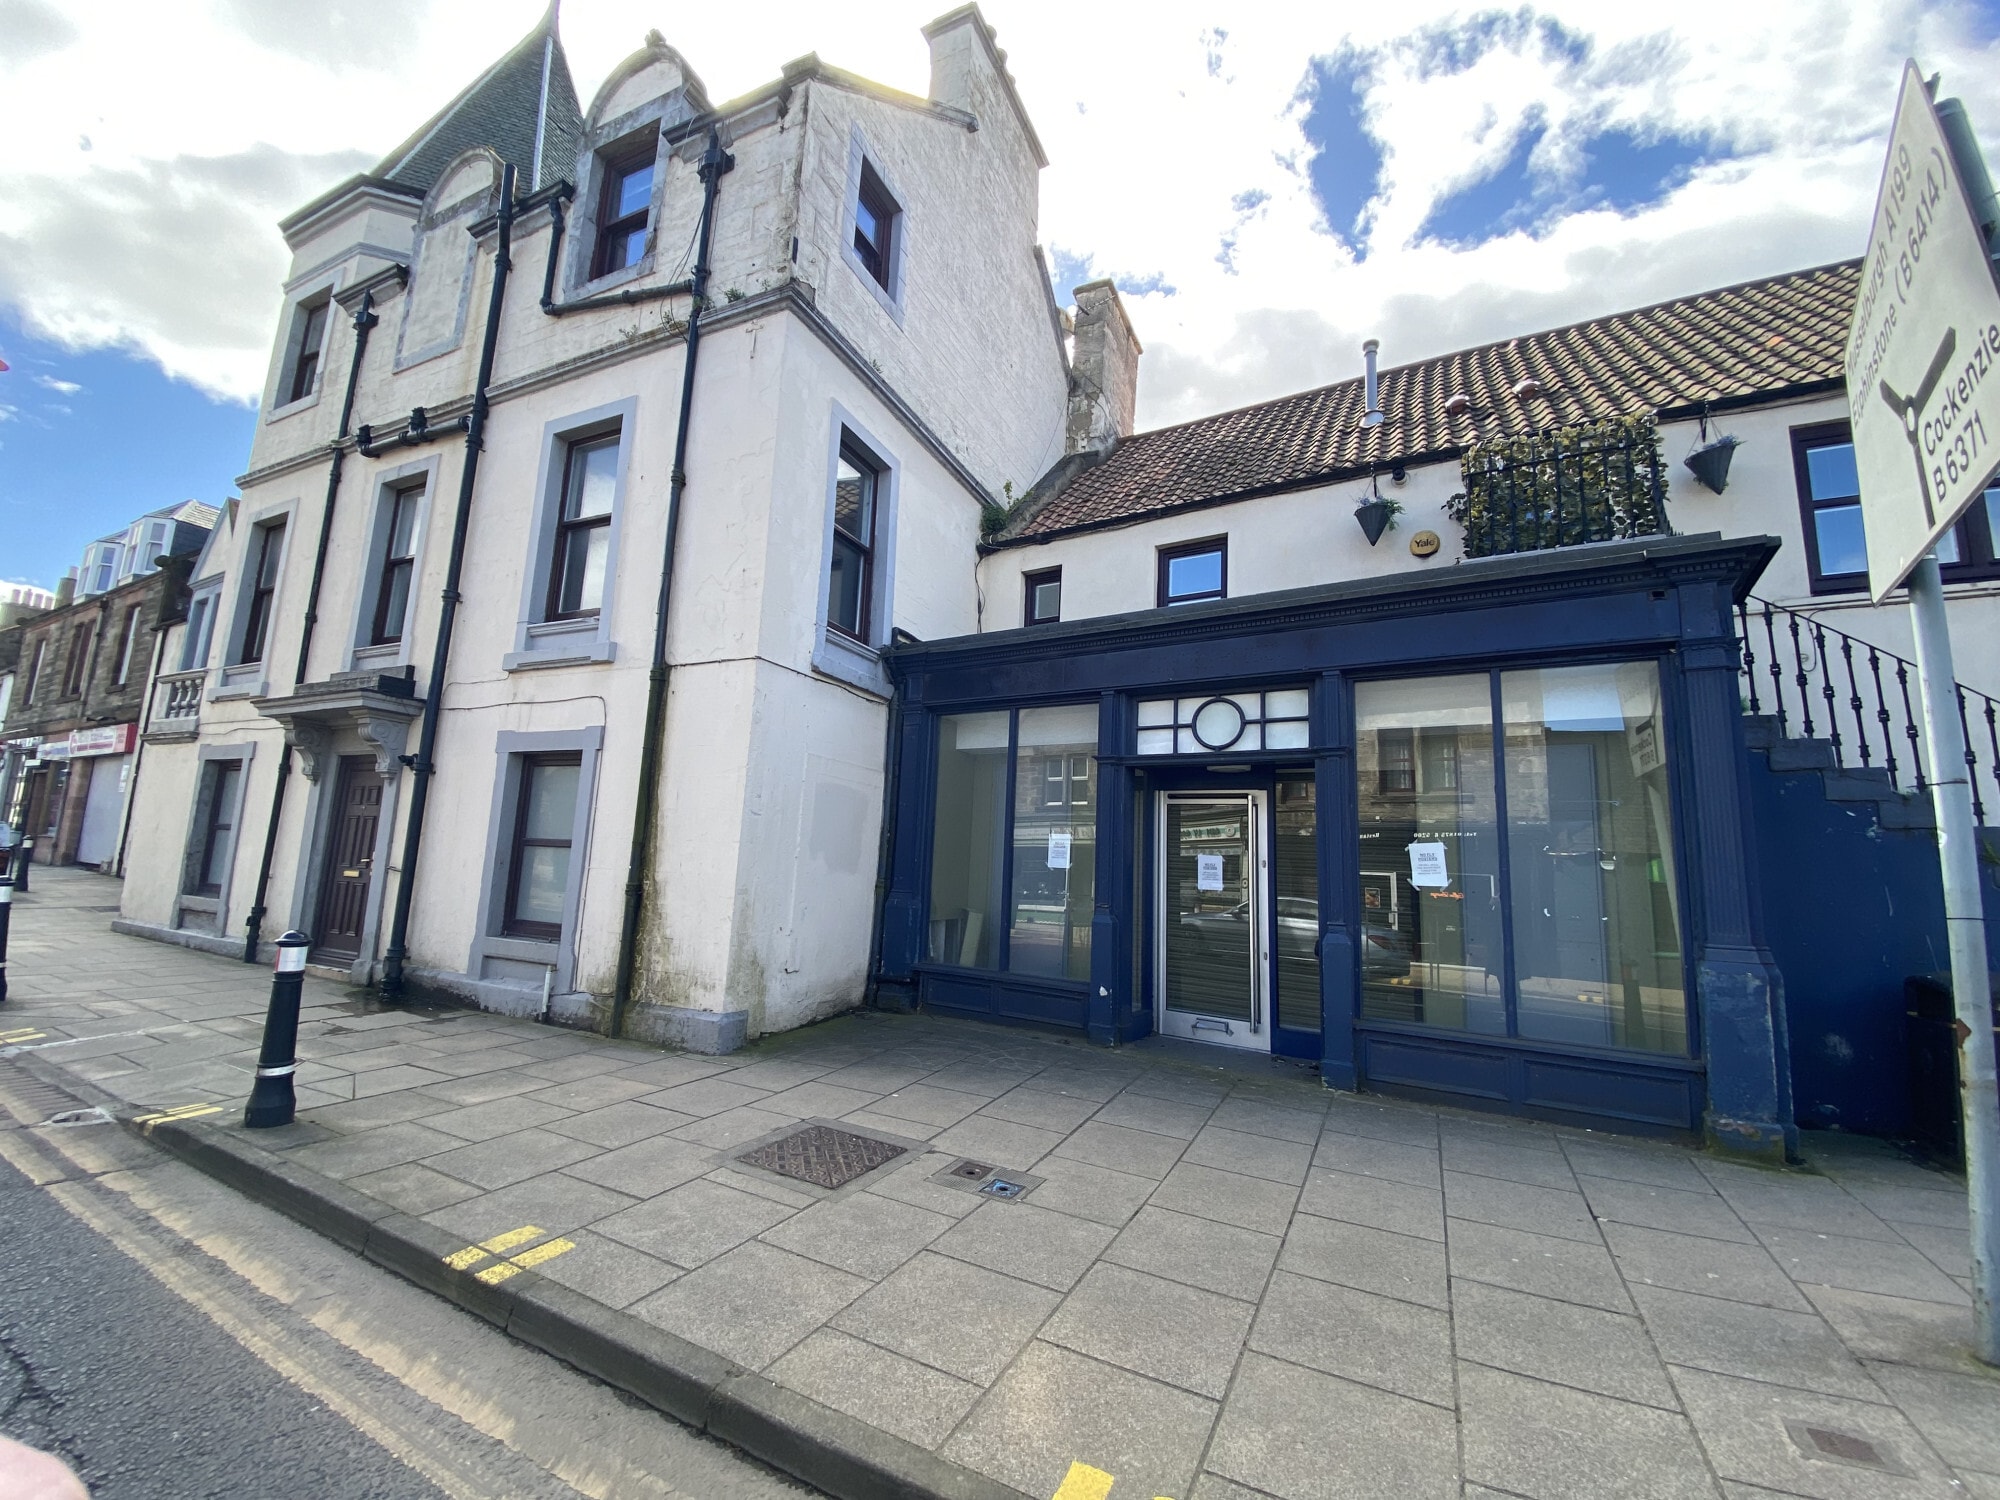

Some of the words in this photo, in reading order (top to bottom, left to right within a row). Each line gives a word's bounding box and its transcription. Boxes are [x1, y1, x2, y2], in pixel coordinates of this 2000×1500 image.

[1852, 303, 1897, 428] Elphinstone
[1923, 323, 2000, 456] Cockenzie
[1414, 538, 1435, 548] Yale
